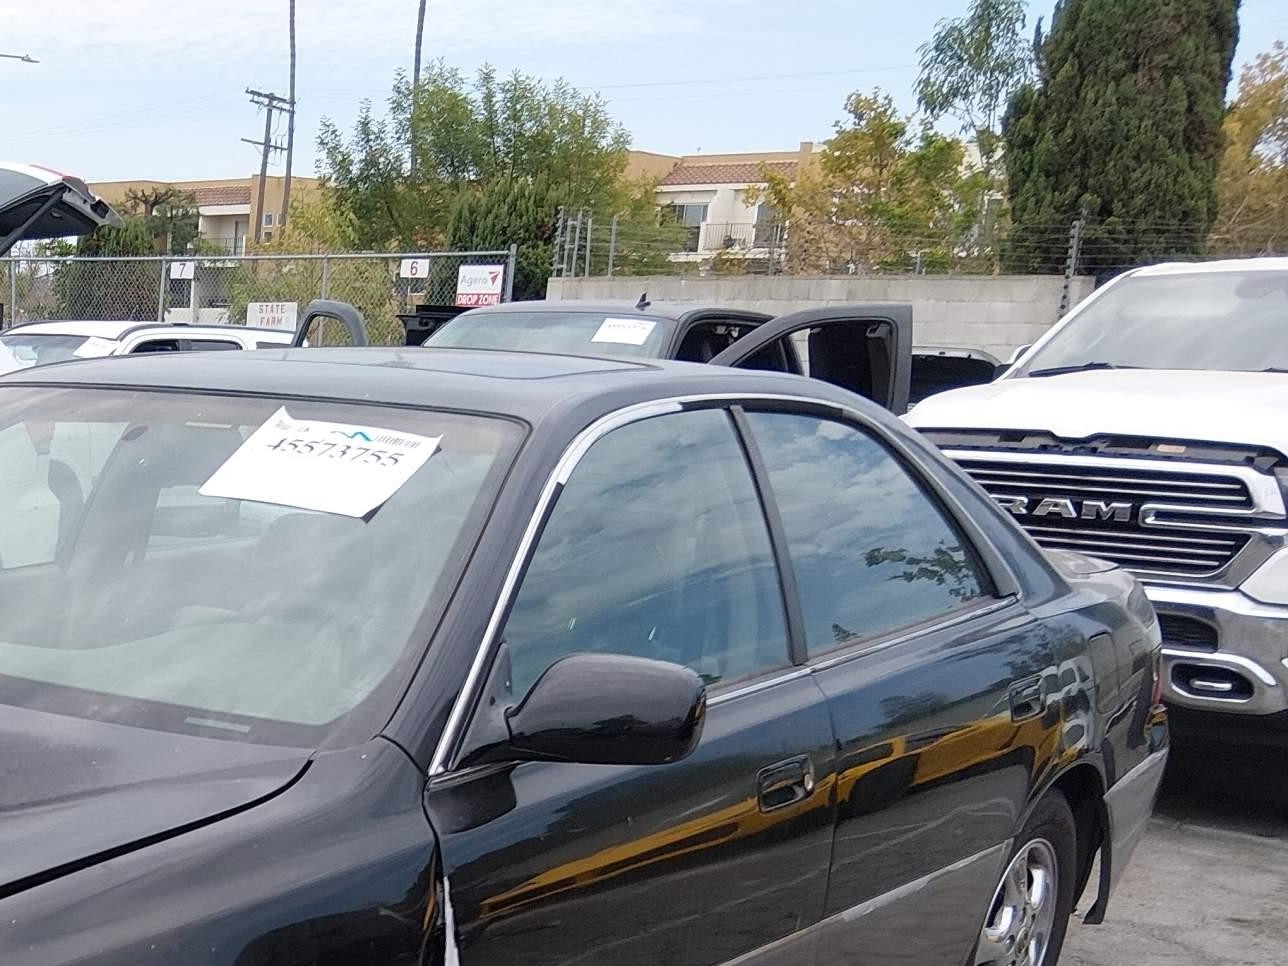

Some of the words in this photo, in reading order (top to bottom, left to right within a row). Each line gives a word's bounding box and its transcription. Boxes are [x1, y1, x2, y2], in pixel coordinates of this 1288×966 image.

[179, 263, 187, 278] 7
[409, 260, 418, 277] 6
[457, 294, 478, 305] DROP
[479, 294, 499, 305] ZONE
[258, 304, 286, 314] STATE
[259, 316, 283, 327] FARM
[267, 438, 405, 467] 45573755
[989, 494, 1133, 522] RAM
